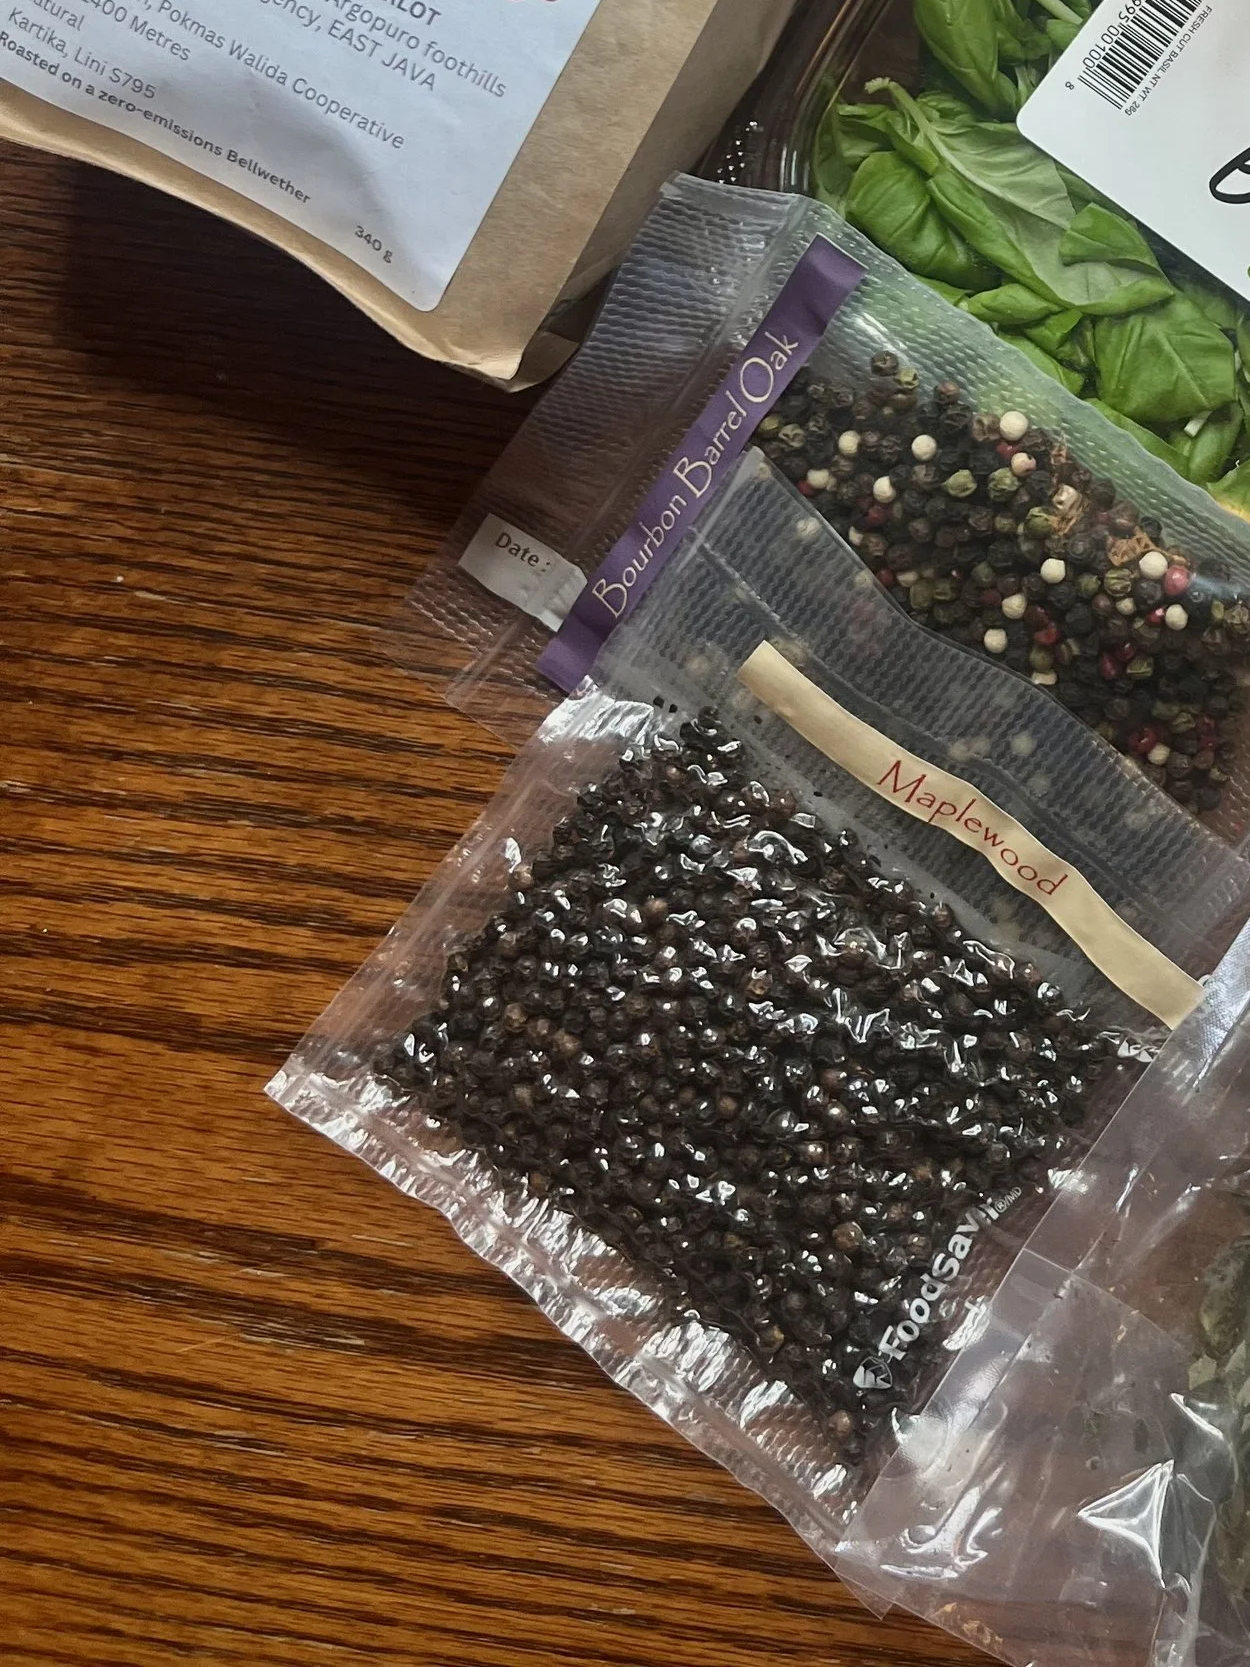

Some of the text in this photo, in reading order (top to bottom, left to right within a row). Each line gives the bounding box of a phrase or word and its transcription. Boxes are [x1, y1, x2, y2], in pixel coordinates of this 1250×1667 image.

[130, 16, 191, 61] Metres
[1189, 5, 1213, 33] FRESH
[8, 6, 156, 99] Kartika, Lini S795
[328, 19, 382, 58] EAST
[381, 53, 436, 90] JAVA
[1082, 24, 1120, 69] 00100
[1161, 49, 1179, 73] BASIL
[1178, 31, 1191, 53] CUT
[158, 0, 226, 49] Pokmas
[229, 40, 287, 86] Walida
[292, 77, 405, 149] Cooperative
[423, 41, 508, 98] foothills
[1064, 81, 1075, 91] 8
[1151, 74, 1162, 88] NT
[0, 31, 312, 203] Roasted on a zero-emissions Bellwether
[1124, 100, 1141, 117] 28g
[354, 225, 393, 264] 340 g
[592, 331, 799, 619] Bourbon Barrel Oak
[876, 760, 1068, 895] Maplewood
